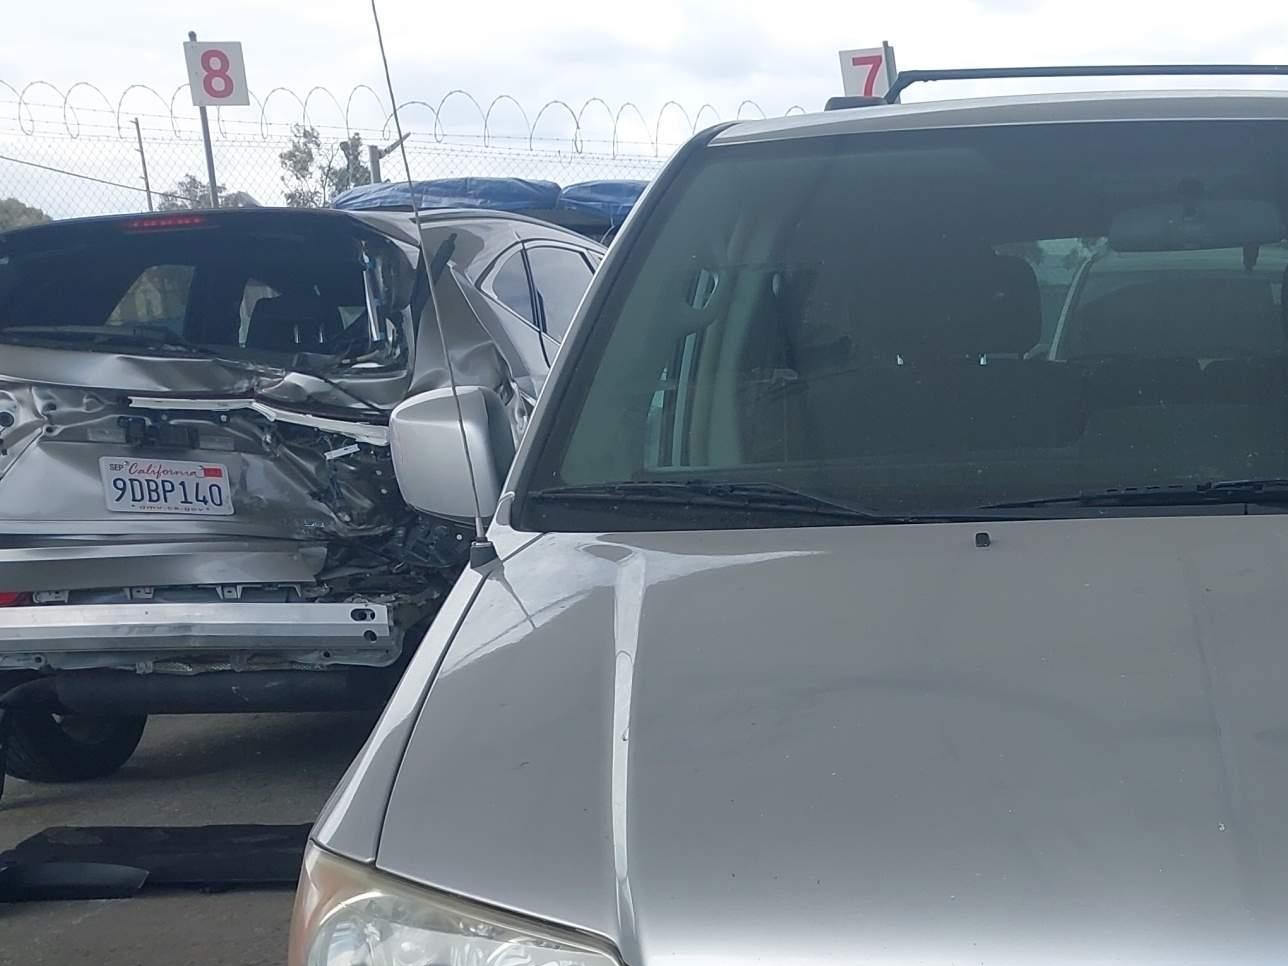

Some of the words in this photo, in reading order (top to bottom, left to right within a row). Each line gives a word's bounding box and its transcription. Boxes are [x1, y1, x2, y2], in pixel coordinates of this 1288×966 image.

[200, 48, 234, 98] 8
[852, 54, 883, 97] 7
[109, 463, 124, 472] SEP
[128, 462, 201, 480] California
[112, 477, 223, 507] 9DBP140
